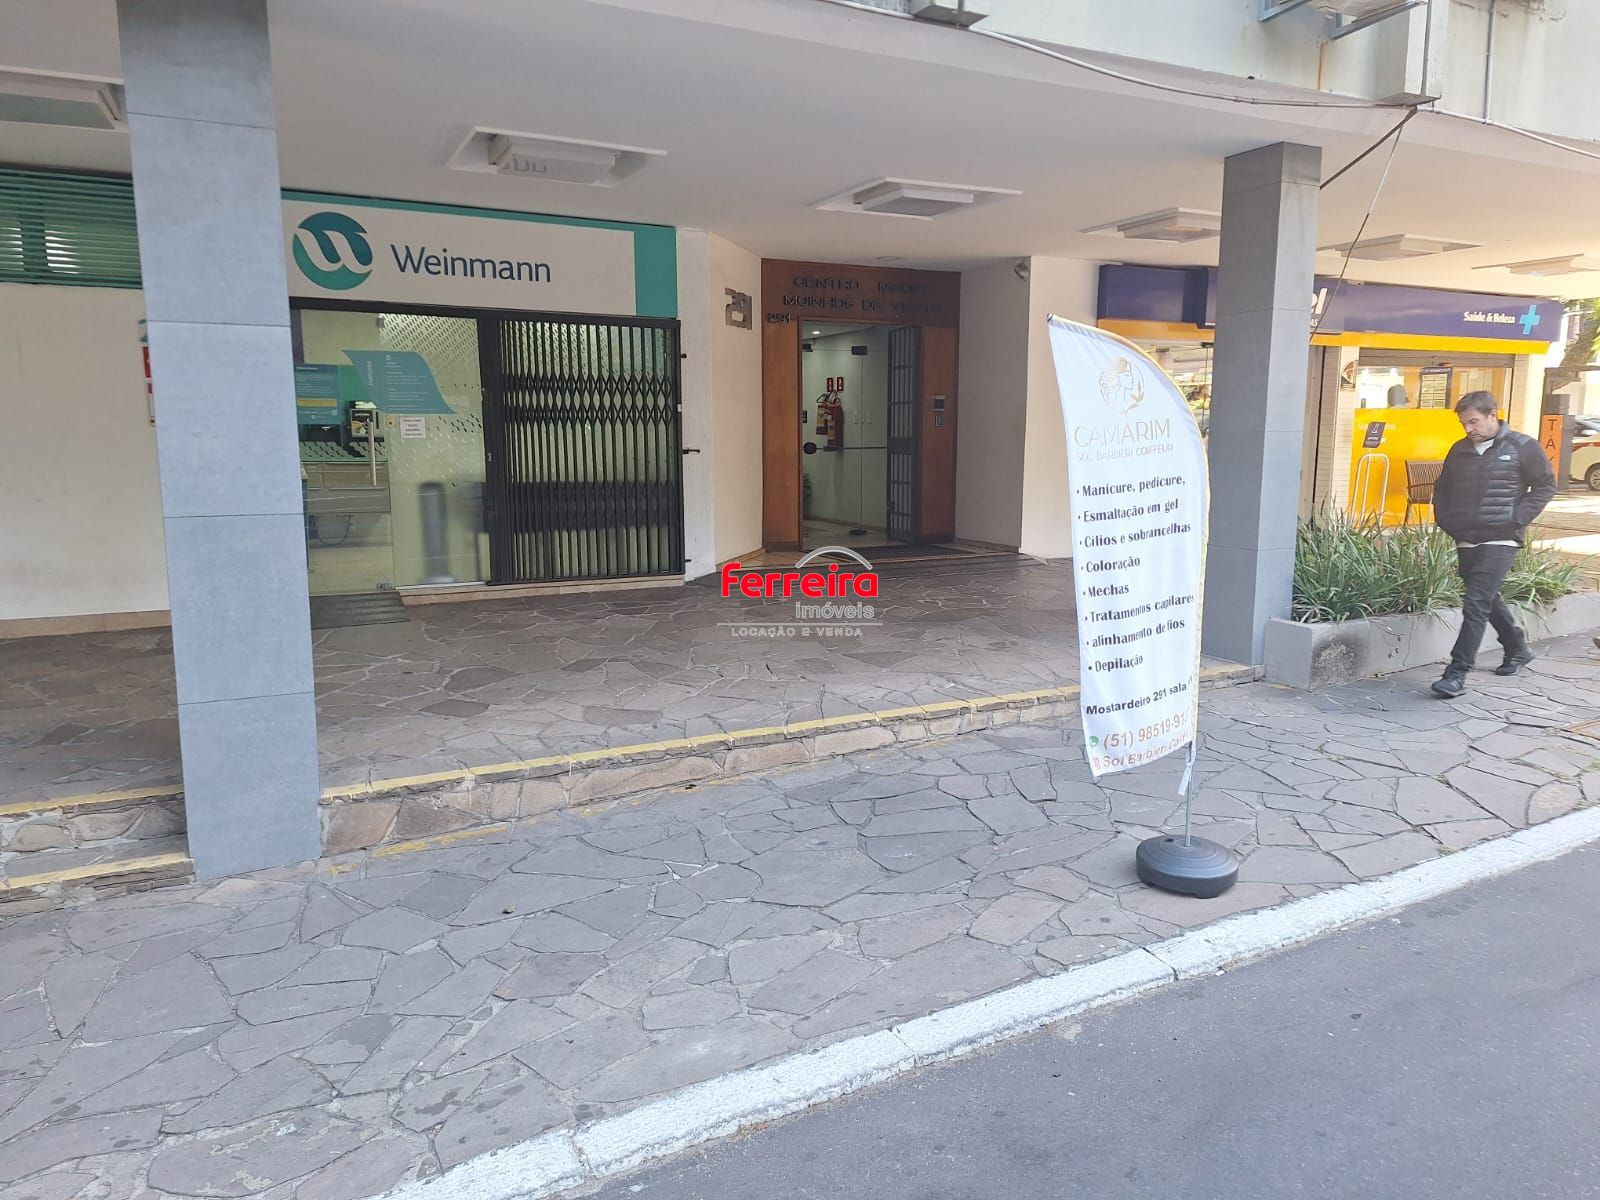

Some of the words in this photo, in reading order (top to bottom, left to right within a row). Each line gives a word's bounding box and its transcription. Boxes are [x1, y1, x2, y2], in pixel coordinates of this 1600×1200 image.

[390, 244, 551, 282] Weinmann
[783, 295, 854, 310] MOINHOS
[1464, 310, 1486, 322] Saúde
[1075, 418, 1170, 447] CAMARIM
[1136, 443, 1174, 456] COIFFEUR
[1082, 481, 1136, 497] Manicure,
[1139, 474, 1186, 493] pedicure,
[1083, 505, 1145, 523] Esmaltação
[1147, 503, 1161, 513] em
[1164, 498, 1179, 514] gel
[1120, 535, 1126, 544] e
[1086, 556, 1141, 573] Coloração
[1088, 583, 1130, 598] Mechas
[1090, 604, 1151, 623] Tratamentos
[1092, 627, 1152, 648] alinhamento
[1156, 623, 1165, 635] de
[1167, 619, 1185, 631] fios
[1095, 655, 1143, 672] Depilação
[1086, 697, 1151, 715] Mostardeiro
[1153, 688, 1167, 701] 291
[1169, 683, 1187, 695] sala
[1103, 730, 1134, 750] (51)
